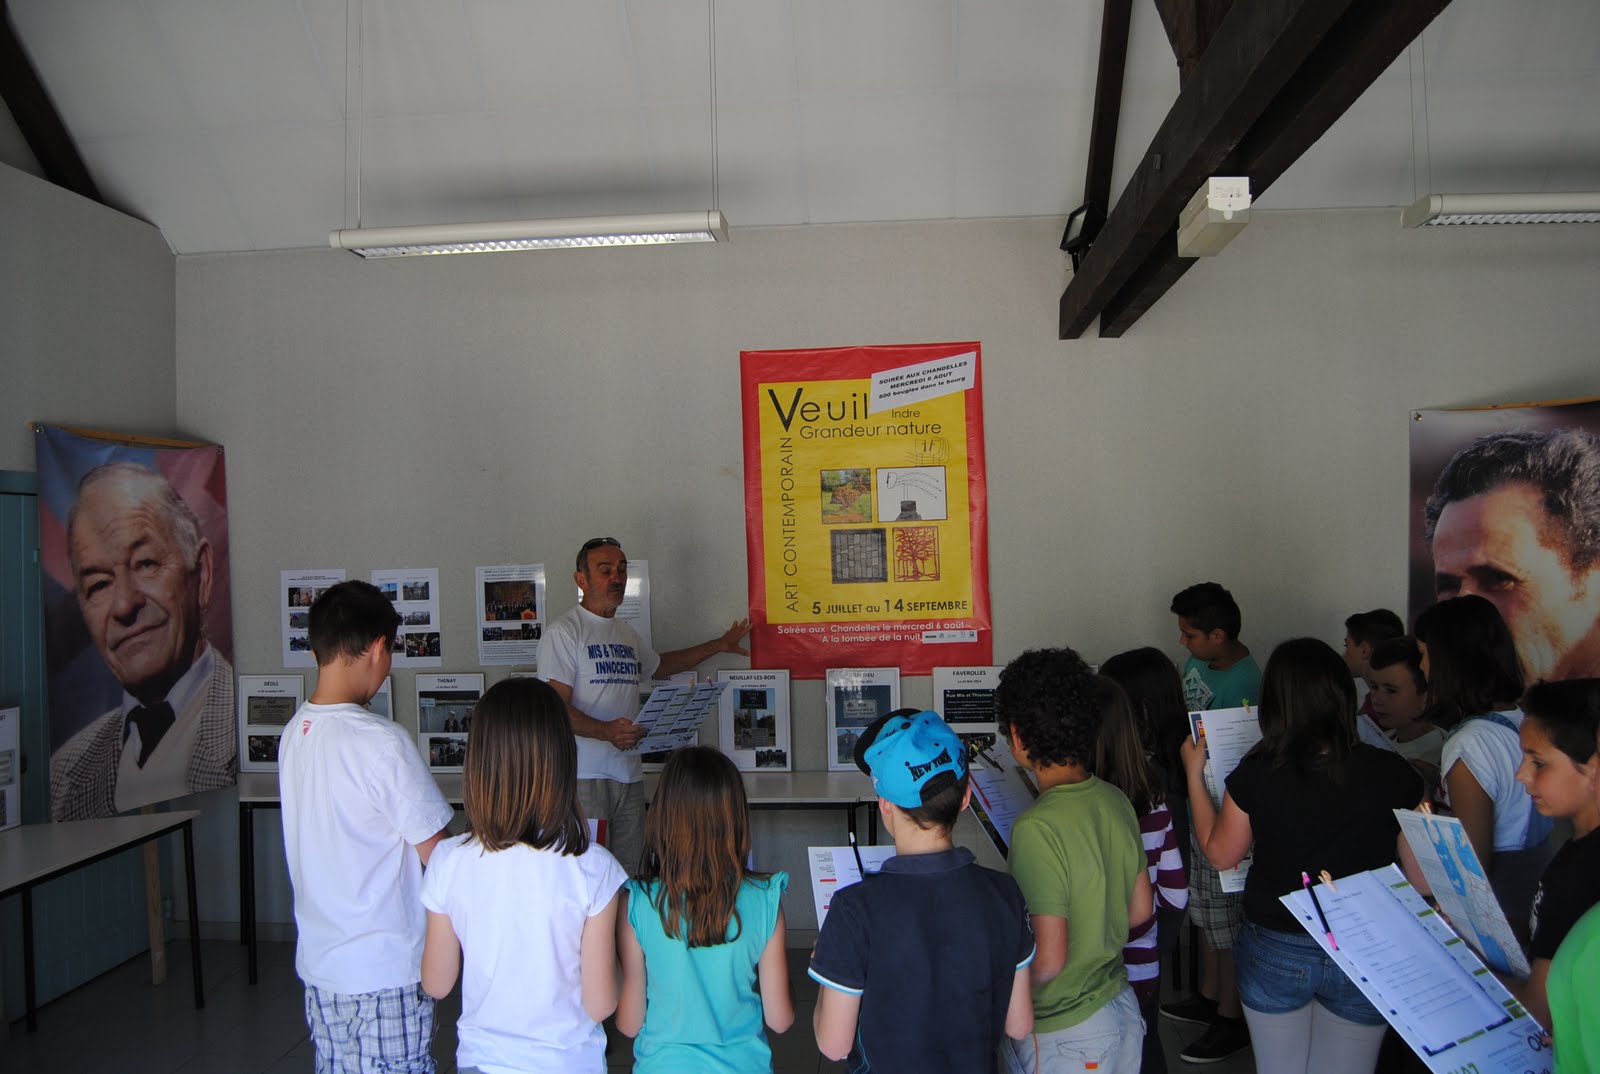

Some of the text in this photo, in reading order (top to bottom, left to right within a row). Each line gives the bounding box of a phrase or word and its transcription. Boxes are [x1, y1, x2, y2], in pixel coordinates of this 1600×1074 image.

[879, 361, 968, 385] SOIRÉE AUX CHANDELLES
[890, 377, 926, 389] MERCREDI
[933, 371, 953, 380] AOUT
[892, 386, 919, 396] bougies
[920, 382, 937, 391] dans
[946, 376, 966, 386] bourg
[768, 387, 868, 432] Veuil
[891, 408, 921, 418] Indre
[800, 421, 942, 439] Grandeur nature
[780, 437, 799, 613] ART CONTEMPORAIN
[812, 598, 968, 615] 5 JUILLET au 14 SEPTEMBRE
[777, 624, 806, 635] Soirée
[809, 626, 826, 634] aux
[830, 623, 880, 633] Chandelles
[882, 623, 892, 631] le
[893, 621, 934, 632] mercredi
[944, 621, 964, 630] août
[822, 635, 829, 643] A
[831, 634, 839, 643] la
[841, 633, 877, 643] tombée
[879, 633, 891, 642] de
[893, 632, 902, 641] la
[588, 645, 602, 659] MIS
[596, 661, 638, 675] INNOCENTS
[905, 761, 932, 782] NEW
